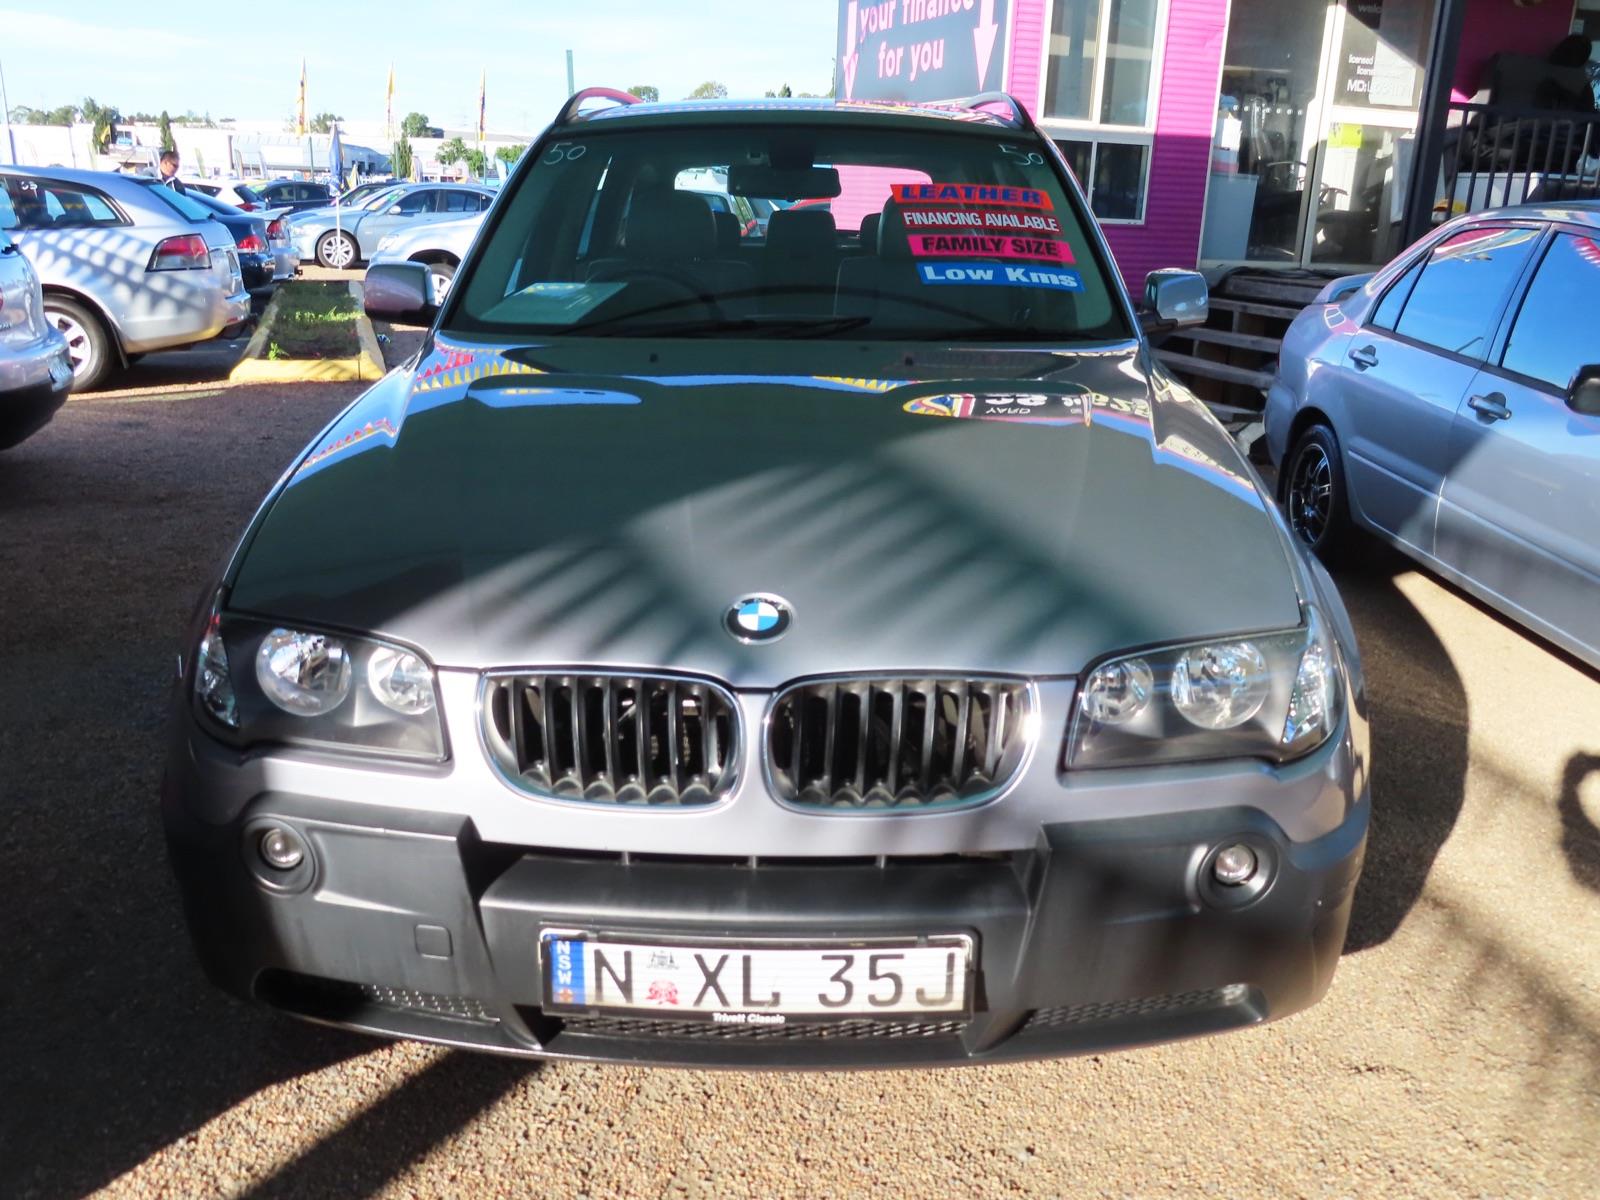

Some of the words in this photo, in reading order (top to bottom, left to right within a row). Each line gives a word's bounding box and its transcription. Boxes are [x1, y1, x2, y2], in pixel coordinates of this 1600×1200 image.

[860, 0, 896, 44] your
[878, 41, 904, 79] for
[910, 39, 945, 82] you
[544, 142, 586, 165] 50
[999, 143, 1044, 166] 50
[901, 185, 1041, 203] LEATHER
[903, 212, 983, 227] FINANCING
[985, 213, 1060, 232] AVAILABLE
[921, 236, 1003, 252] FAMILY
[1011, 239, 1059, 256] SIZE
[924, 266, 994, 281] Low
[1004, 267, 1078, 288] Kms
[557, 941, 572, 985] NSW
[818, 952, 956, 1007] 35J
